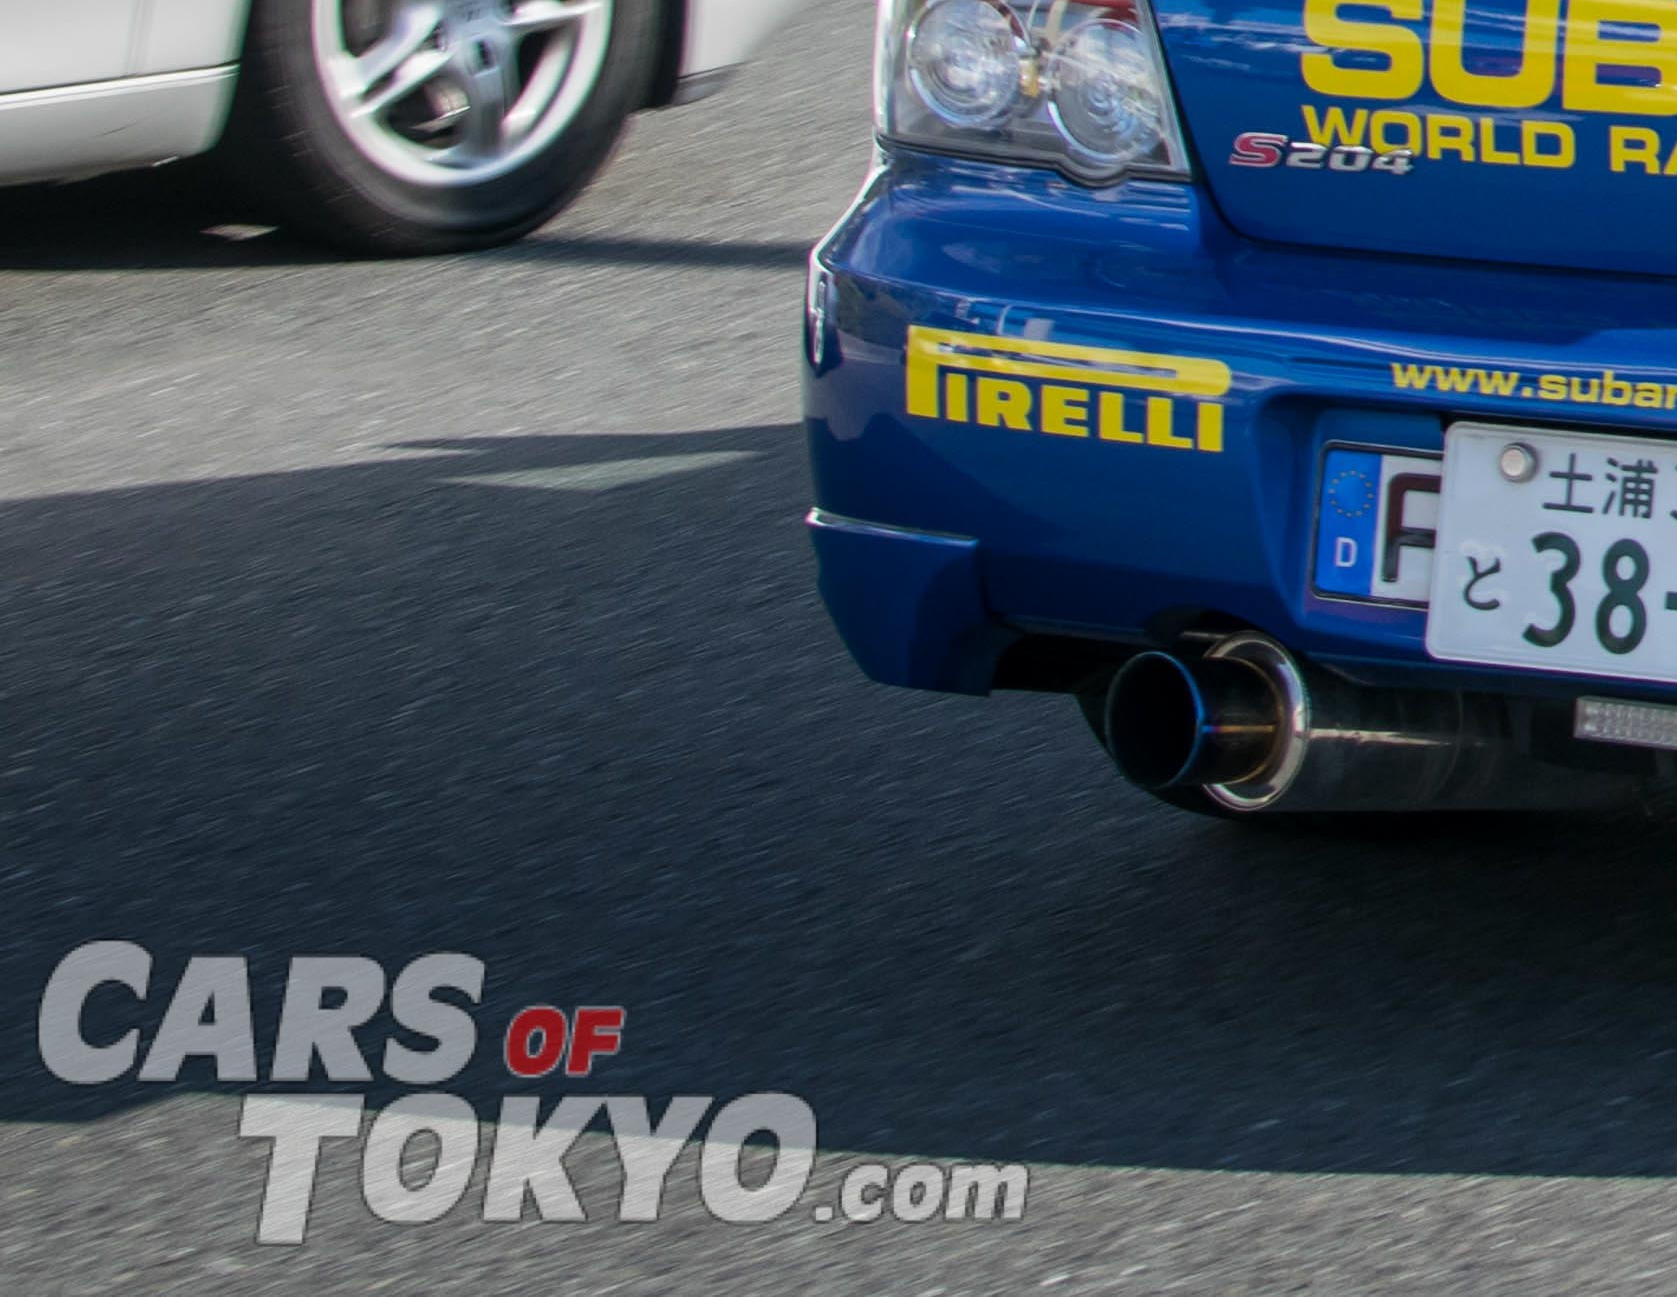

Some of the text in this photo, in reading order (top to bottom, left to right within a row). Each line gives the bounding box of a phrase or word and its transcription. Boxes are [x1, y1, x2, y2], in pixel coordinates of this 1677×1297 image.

[1228, 132, 1415, 176] S204
[1301, 105, 1576, 169] WORLD
[905, 325, 1232, 453] PIRELLI
[1542, 453, 1660, 520] 土浦
[1334, 536, 1358, 568] D
[1462, 556, 1503, 611] と
